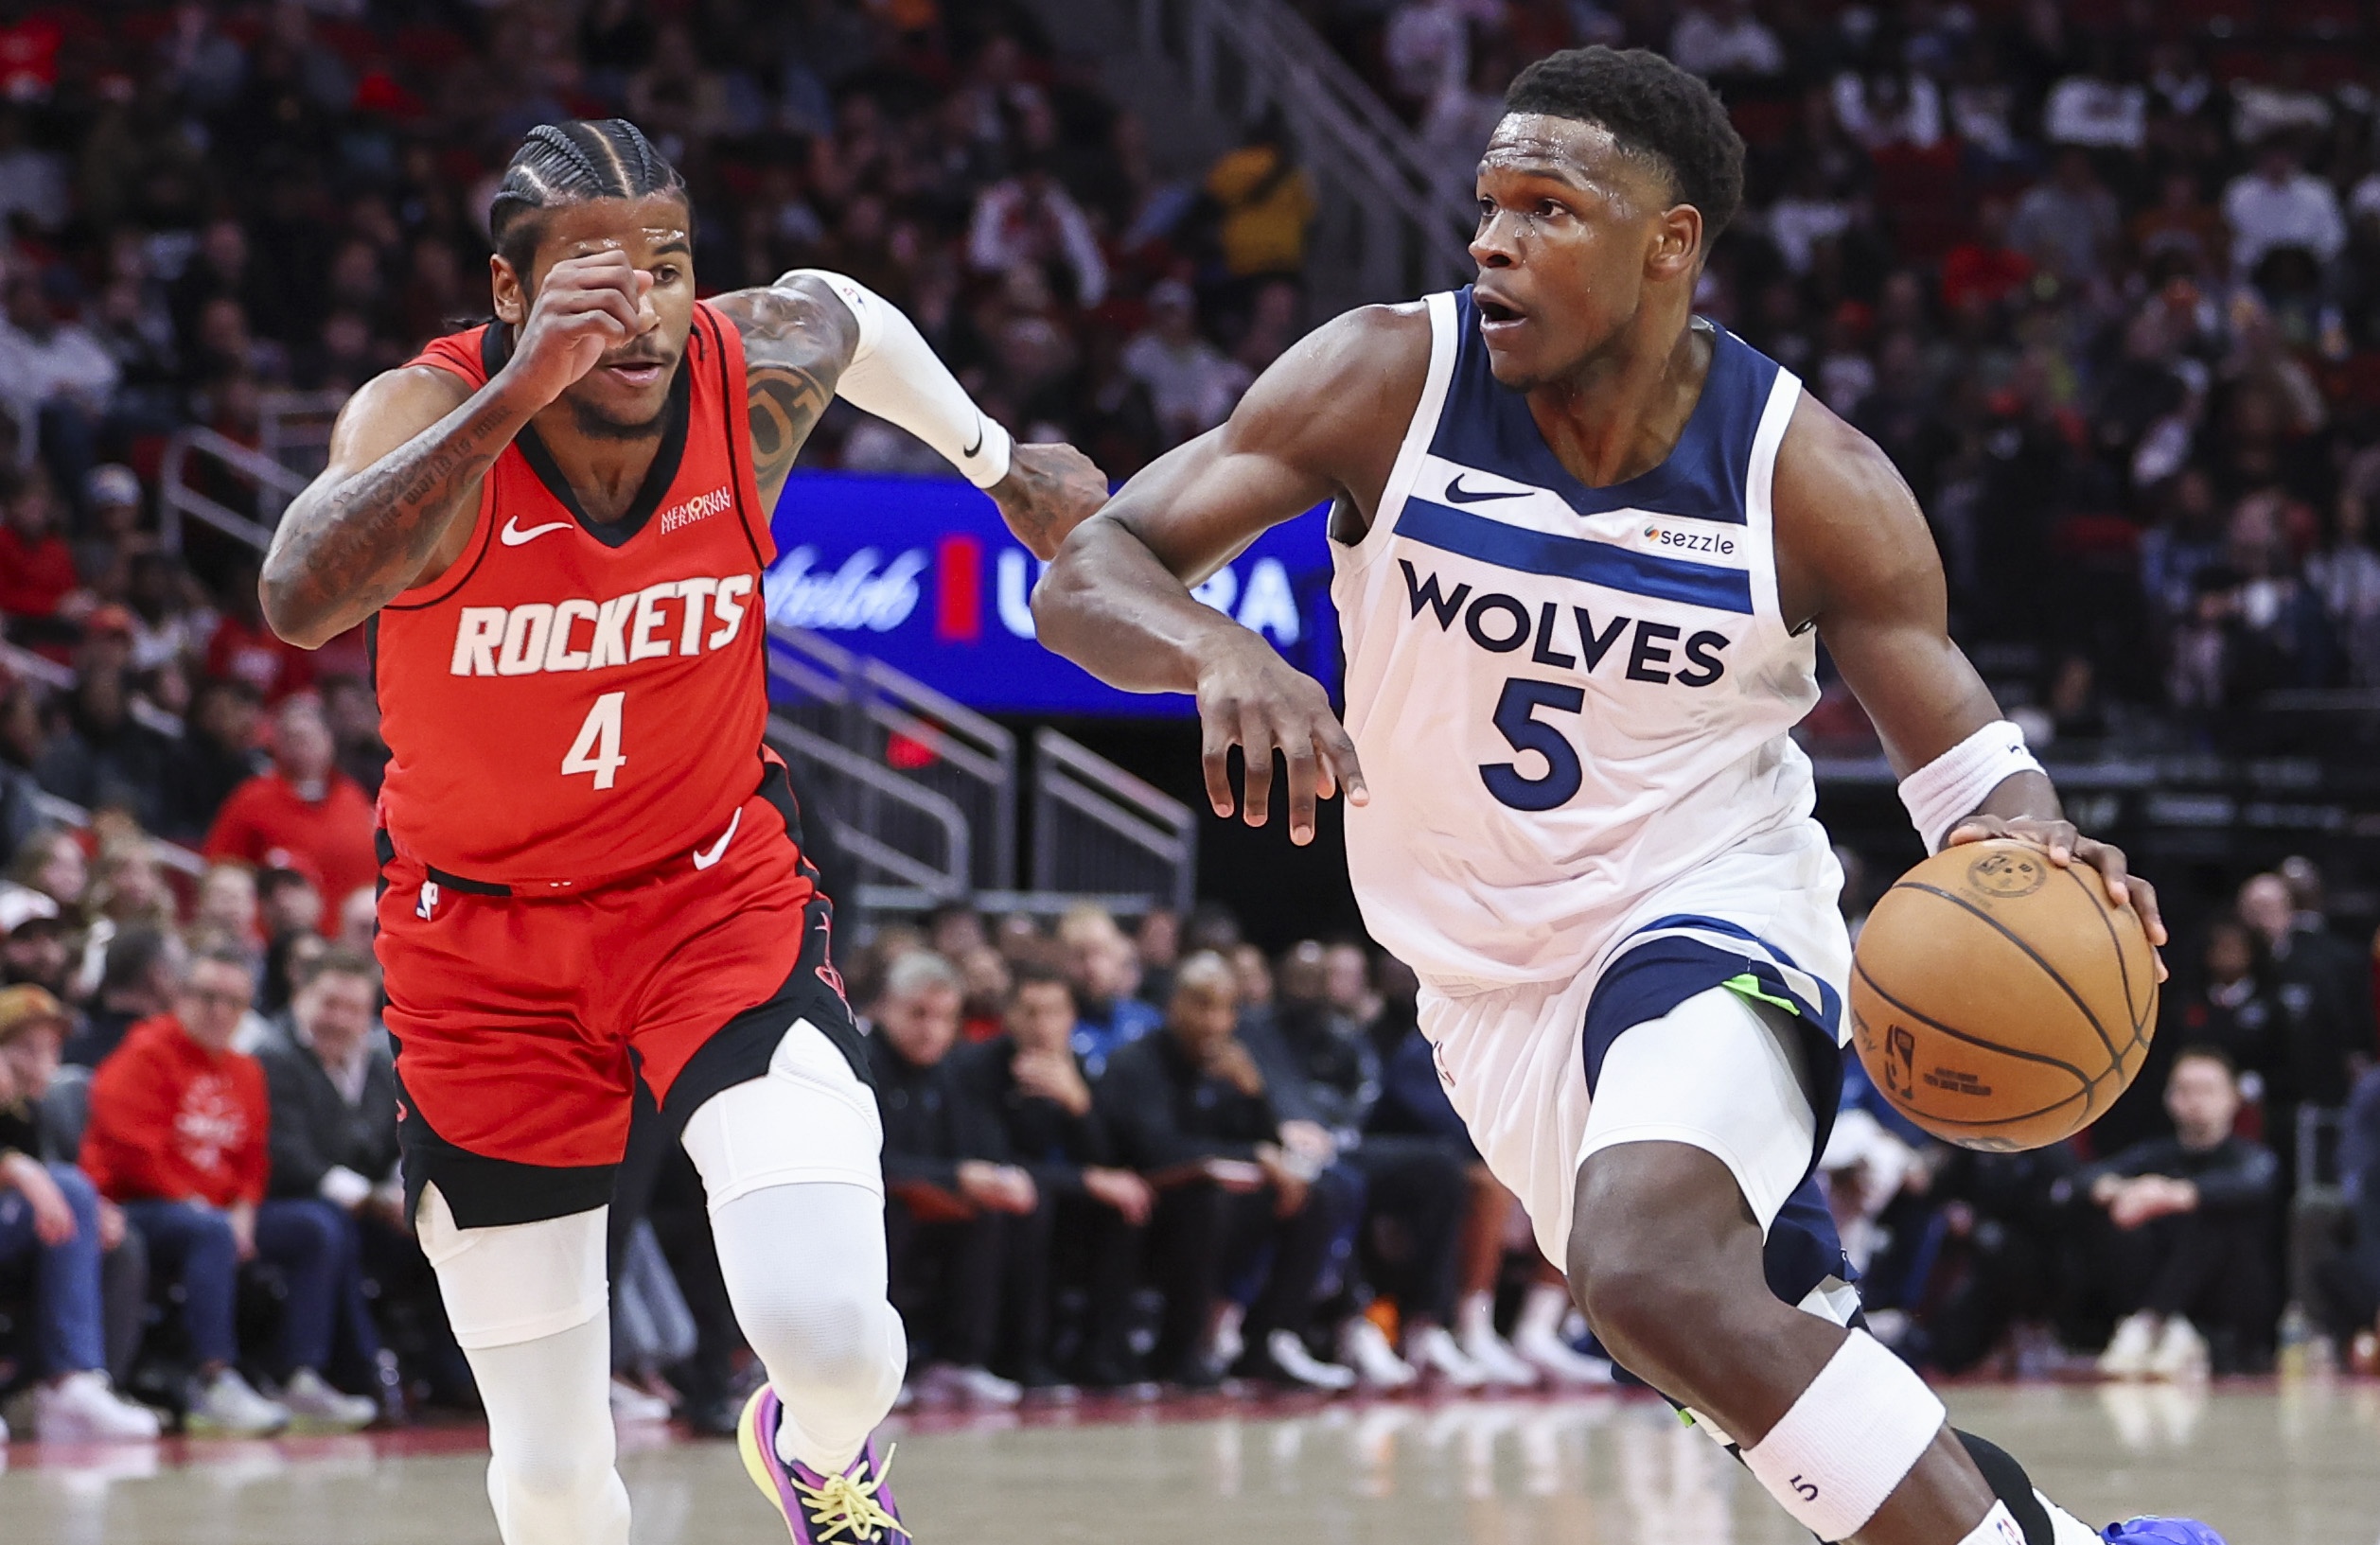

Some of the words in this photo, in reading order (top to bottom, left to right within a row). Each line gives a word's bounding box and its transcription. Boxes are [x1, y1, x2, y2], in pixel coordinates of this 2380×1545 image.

[661, 485, 730, 523] MEMORIAL
[661, 493, 732, 535] HERMANN
[1660, 528, 1735, 556] sezzle
[450, 573, 752, 677] ROCKETS
[1398, 558, 1731, 688] WOLVES
[561, 691, 627, 791] 4
[1478, 676, 1586, 812] 5
[1789, 1473, 1819, 1502] 5
